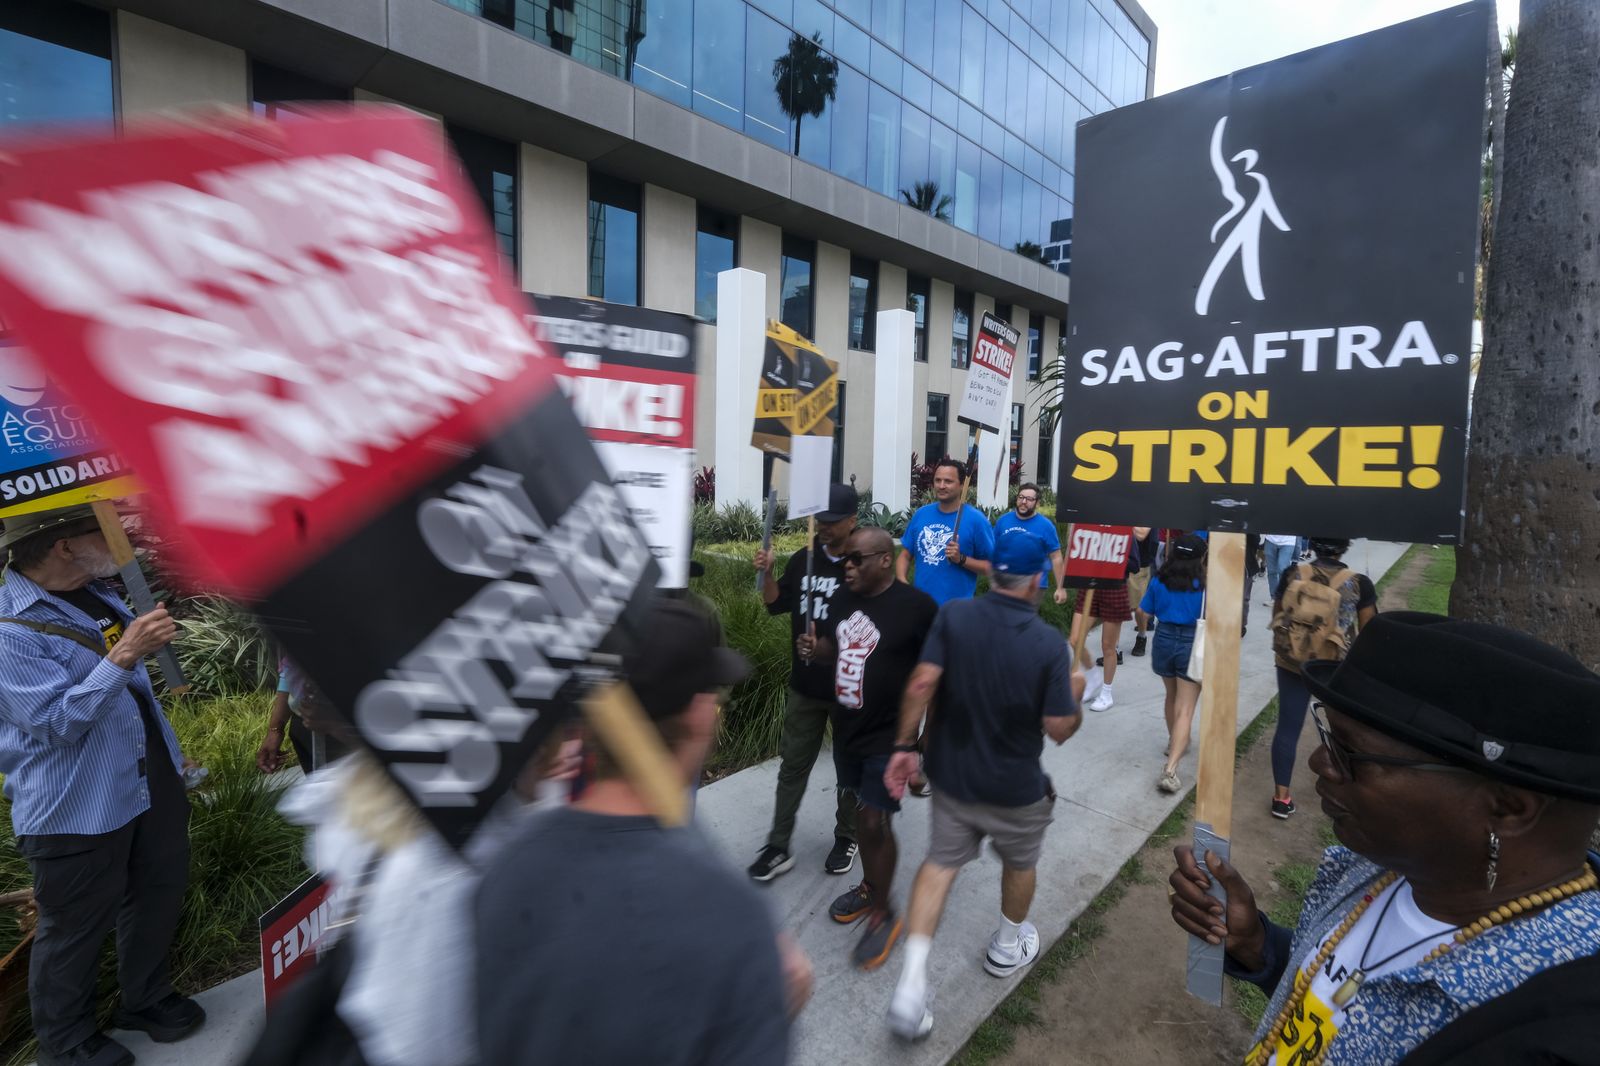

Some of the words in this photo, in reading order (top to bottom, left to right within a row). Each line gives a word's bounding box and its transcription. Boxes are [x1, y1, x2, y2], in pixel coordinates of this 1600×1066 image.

[975, 338, 1013, 375] STRIKE!
[2, 404, 85, 429] ACTO
[762, 393, 777, 412] ON
[1197, 389, 1270, 421] ON
[1071, 425, 1444, 489] STRIKE!
[0, 454, 122, 501] SOLIDARI
[1070, 528, 1129, 564] STRIKE!
[838, 646, 869, 708] WGA
